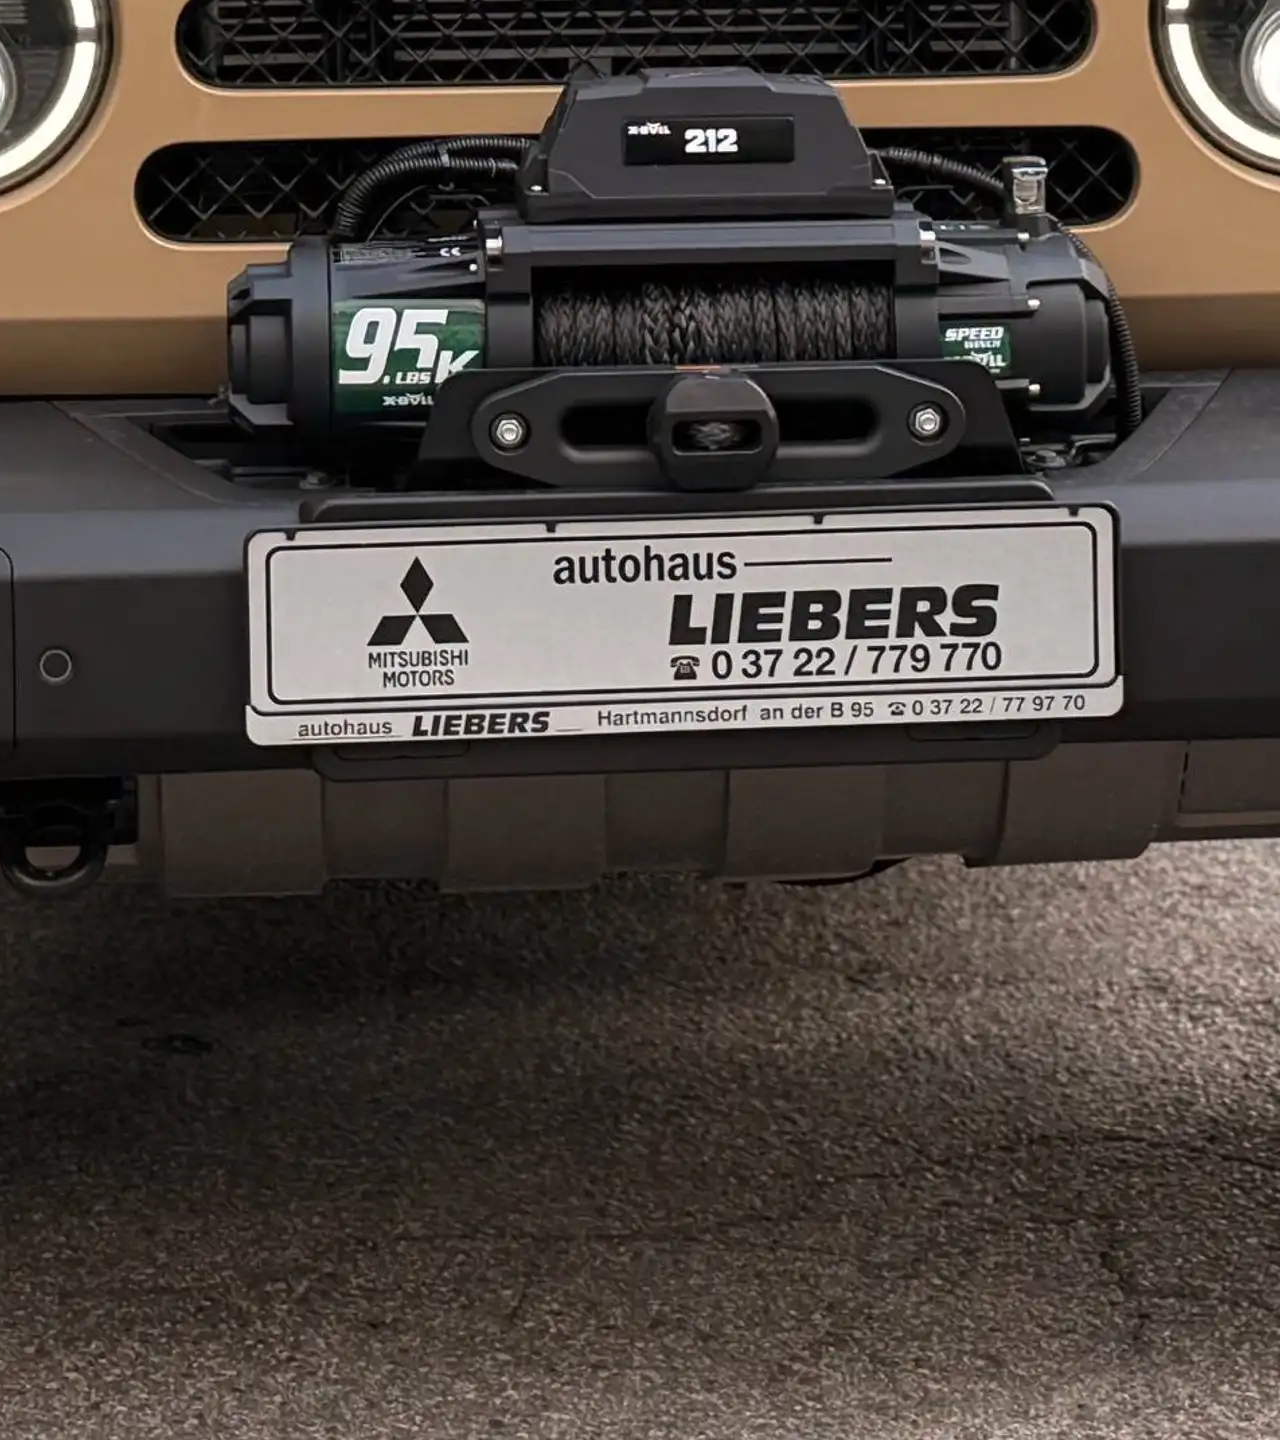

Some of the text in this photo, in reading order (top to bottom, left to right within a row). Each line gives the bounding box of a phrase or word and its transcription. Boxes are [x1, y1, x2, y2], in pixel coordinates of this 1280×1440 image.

[684, 128, 739, 153] 212
[944, 326, 1004, 341] SPEED
[964, 340, 1001, 349] WINCH
[395, 371, 432, 385] LBS
[552, 545, 737, 585] autohaus
[668, 583, 1000, 646] LIEBERS
[368, 649, 469, 669] MITSUBISHI
[711, 650, 733, 680] 0
[793, 647, 836, 677] 22
[867, 644, 931, 674] 779
[940, 641, 1002, 671] 770
[383, 669, 455, 688] MOTORS
[297, 719, 393, 738] autohaus
[411, 710, 551, 737] LIEBERS
[597, 705, 748, 727] Hartmannsdorf
[760, 707, 784, 721] an
[791, 703, 824, 720] der
[830, 702, 844, 718] B
[850, 701, 874, 718] 95
[930, 699, 954, 715] 37
[960, 698, 983, 714] 22
[1003, 697, 1026, 712] 77
[1032, 696, 1055, 711] 97
[1062, 694, 1086, 711] 70
